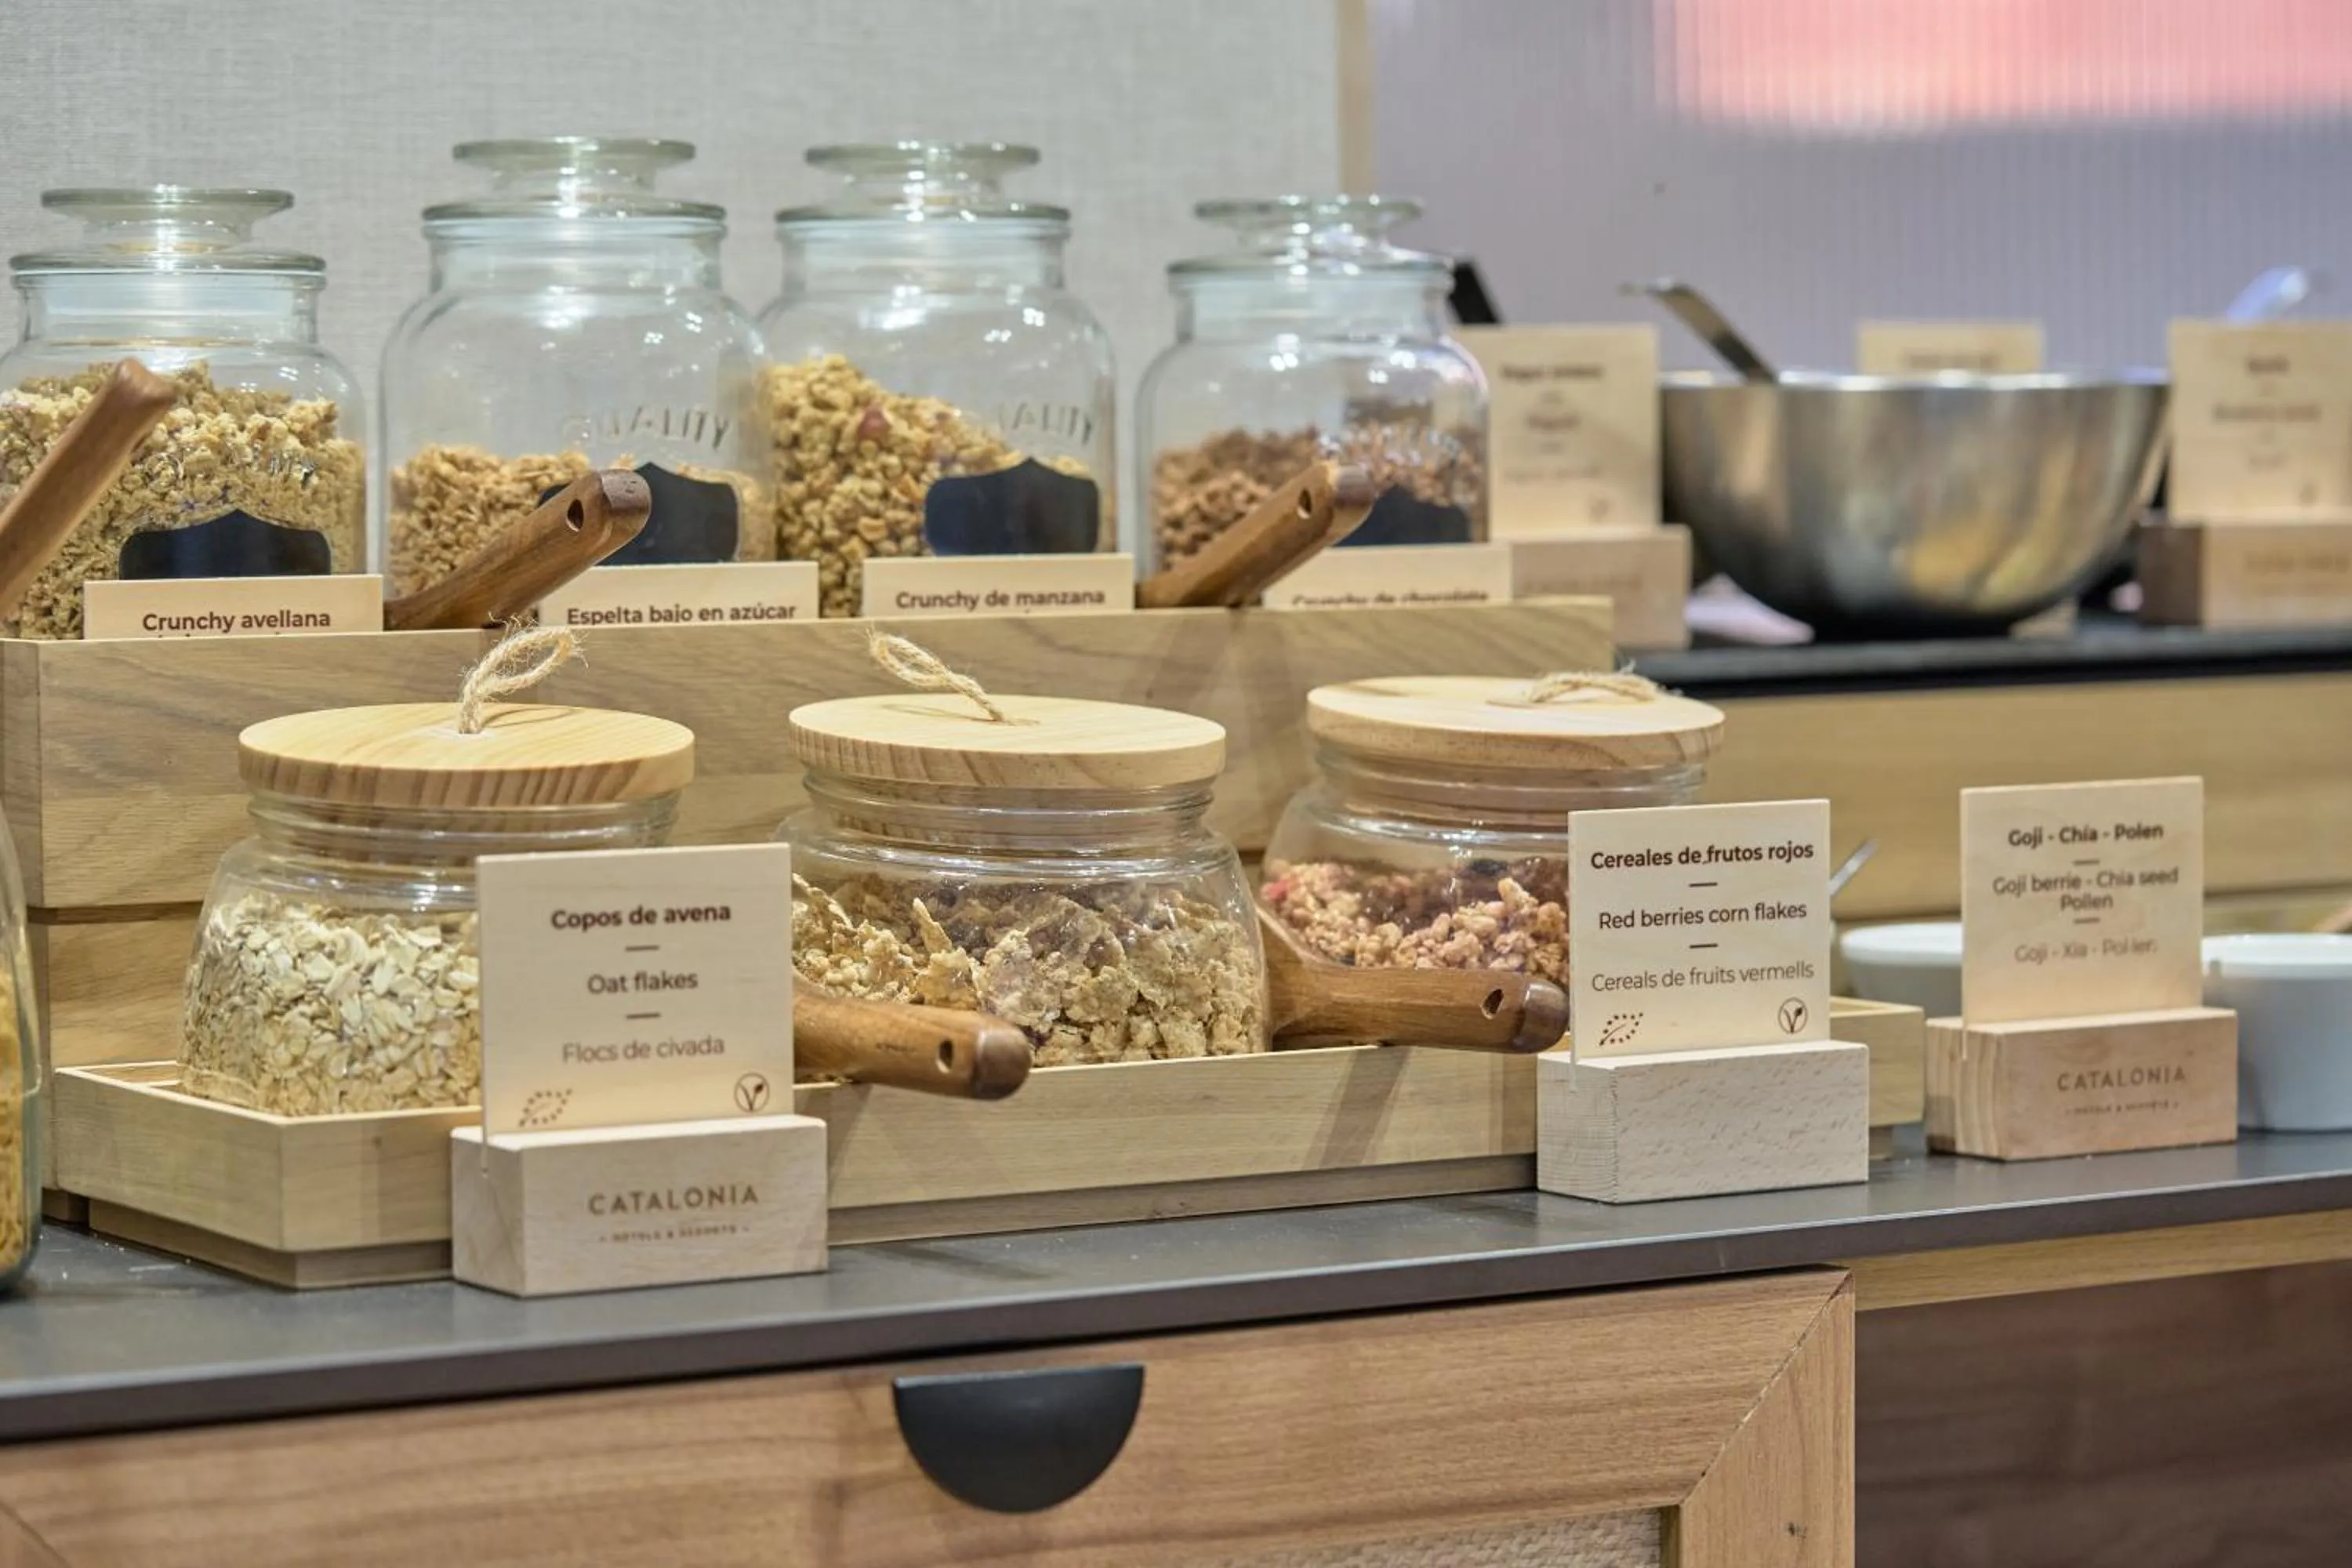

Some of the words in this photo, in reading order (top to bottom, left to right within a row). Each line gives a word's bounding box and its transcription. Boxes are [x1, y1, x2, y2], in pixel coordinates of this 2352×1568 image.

[567, 606, 643, 626] Espelta
[649, 604, 693, 623] bajo
[699, 607, 724, 621] en
[730, 602, 797, 621] azúcar
[895, 590, 979, 612] Crunchy
[985, 590, 1010, 607] de
[1015, 590, 1105, 606] manzana
[142, 611, 235, 633] Crunchy
[241, 609, 331, 629] avellana
[2008, 826, 2042, 849] Goji
[2114, 822, 2164, 841] Polen
[1591, 848, 1673, 869] Cereales
[1678, 846, 1702, 864] de
[1706, 844, 1763, 863] frutos
[1768, 840, 1814, 863] rojos
[1992, 875, 2027, 897] Goji
[2031, 872, 2082, 893] berrie
[2139, 866, 2180, 887] seed
[2060, 892, 2114, 911] Pollen
[550, 909, 623, 932] Copos
[628, 905, 658, 925] de
[663, 906, 731, 924] avena
[1599, 910, 1635, 929] Red
[1641, 907, 1704, 927] berries
[1708, 906, 1749, 924] corn
[1755, 902, 1807, 920] flakes
[2014, 944, 2048, 965] Goji
[587, 973, 628, 994] Oat
[633, 971, 699, 991] flakes
[1592, 971, 1658, 992] Cereals
[1661, 969, 1686, 986] de
[1690, 966, 1736, 985] fruits
[1739, 960, 1815, 982] vermells
[561, 1042, 619, 1063] Flocs
[622, 1040, 652, 1060] de
[655, 1035, 725, 1058] civada
[2056, 1065, 2187, 1092] CATALONIA
[589, 1183, 759, 1216] CATALONIA
